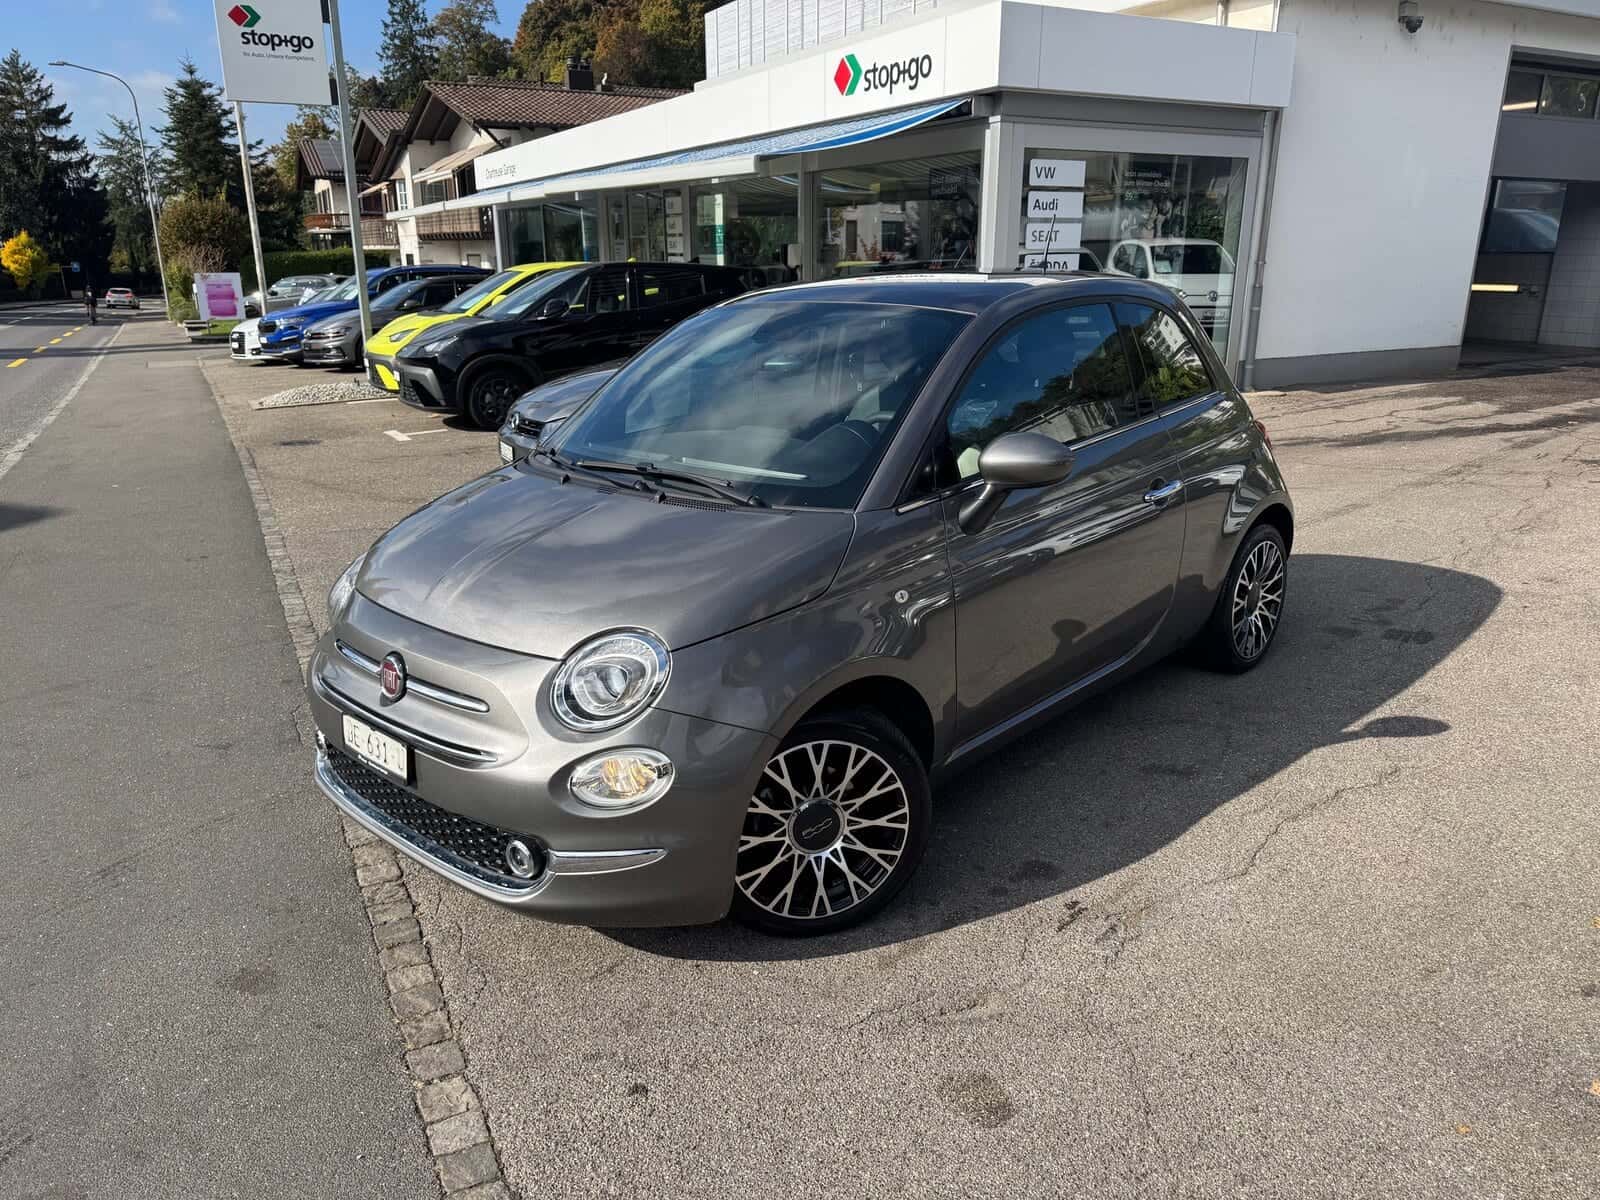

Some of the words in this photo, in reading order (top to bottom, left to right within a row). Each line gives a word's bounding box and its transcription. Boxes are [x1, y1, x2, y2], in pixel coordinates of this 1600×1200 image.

[241, 29, 314, 53] stop+go
[863, 54, 932, 95] stop+go
[1035, 166, 1056, 179] VW
[1032, 198, 1059, 211] Audi
